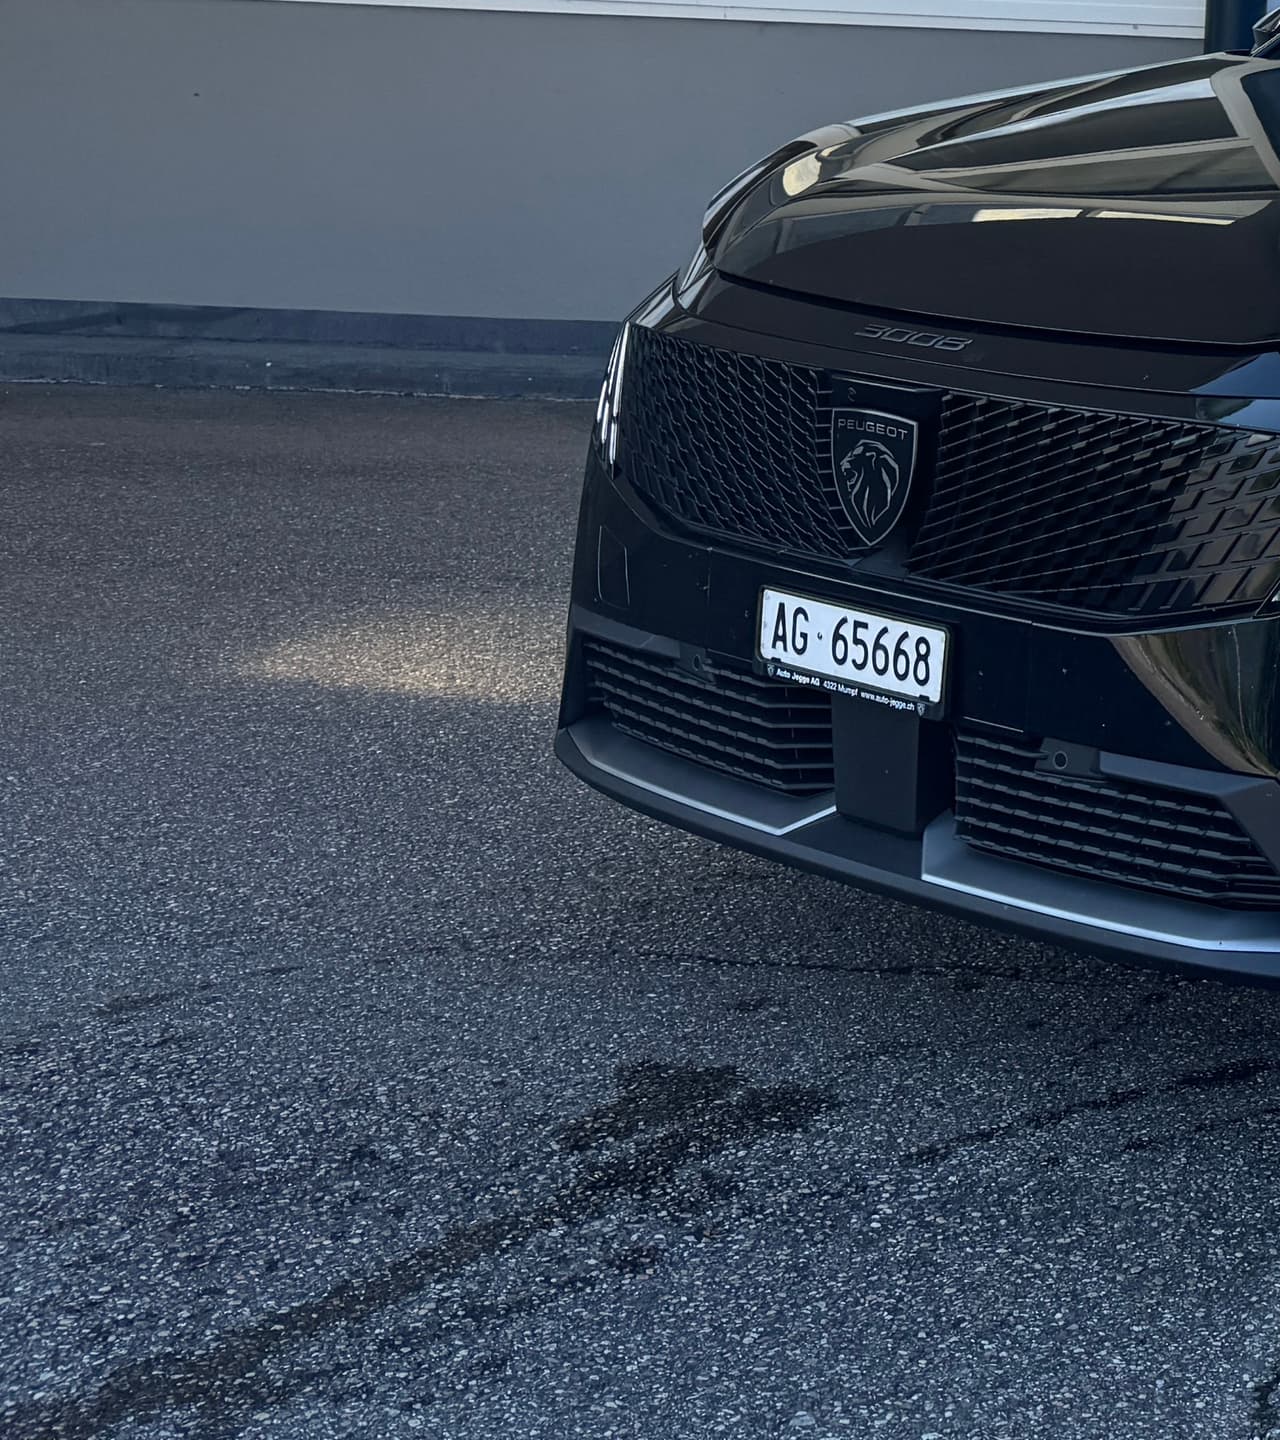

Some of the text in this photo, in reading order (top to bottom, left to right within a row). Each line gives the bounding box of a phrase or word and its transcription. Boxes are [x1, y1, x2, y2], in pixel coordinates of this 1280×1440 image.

[853, 323, 974, 351] 3008
[837, 418, 909, 441] PEUGEOT
[771, 601, 931, 687] AG 65668
[776, 668, 791, 679] Auto
[791, 673, 810, 685] Jegge
[810, 677, 820, 687] AG
[823, 681, 837, 691] 4322
